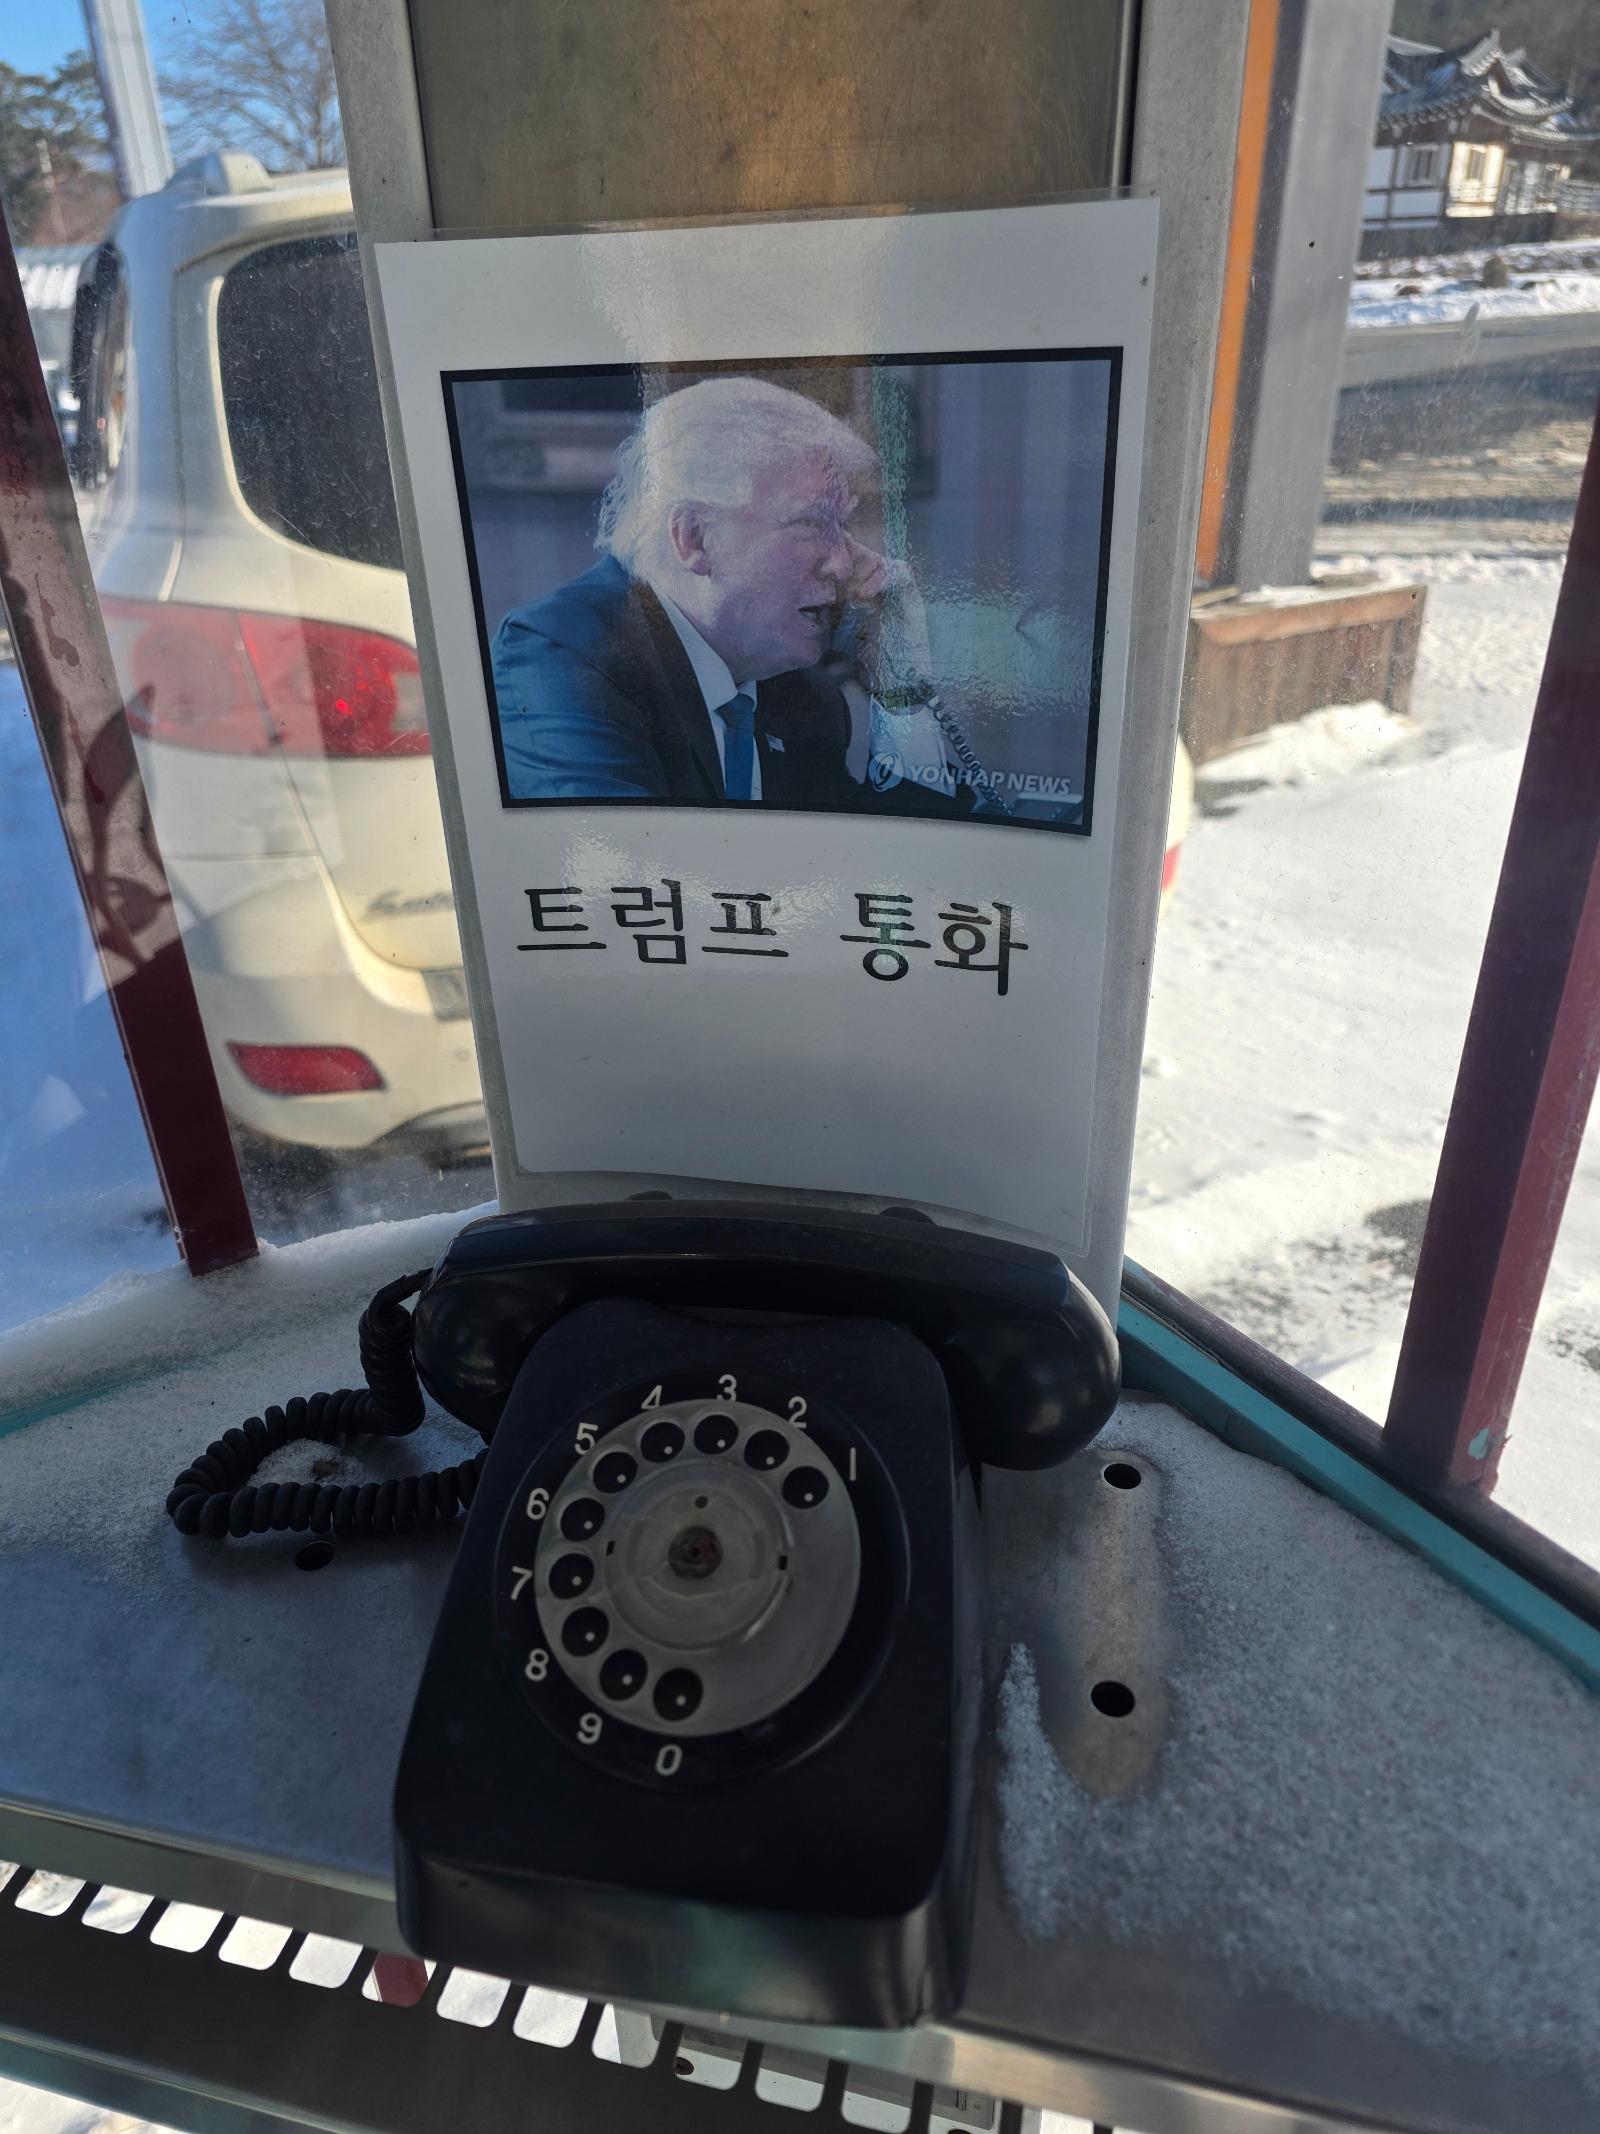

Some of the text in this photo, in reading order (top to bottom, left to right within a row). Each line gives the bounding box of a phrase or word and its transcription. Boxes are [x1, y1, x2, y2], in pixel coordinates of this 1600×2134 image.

[910, 764, 1071, 796] YONHAP NEWS
[517, 879, 1029, 996] 트럼프 통화
[641, 1385, 663, 1409] 4
[717, 1374, 738, 1402] 3
[788, 1396, 808, 1429] 2
[574, 1423, 598, 1455] 5
[849, 1447, 857, 1481] 1
[526, 1488, 549, 1520] 6
[510, 1566, 533, 1600] 7
[525, 1648, 549, 1682] 8
[577, 1713, 603, 1744] 9
[655, 1744, 683, 1776] 0
